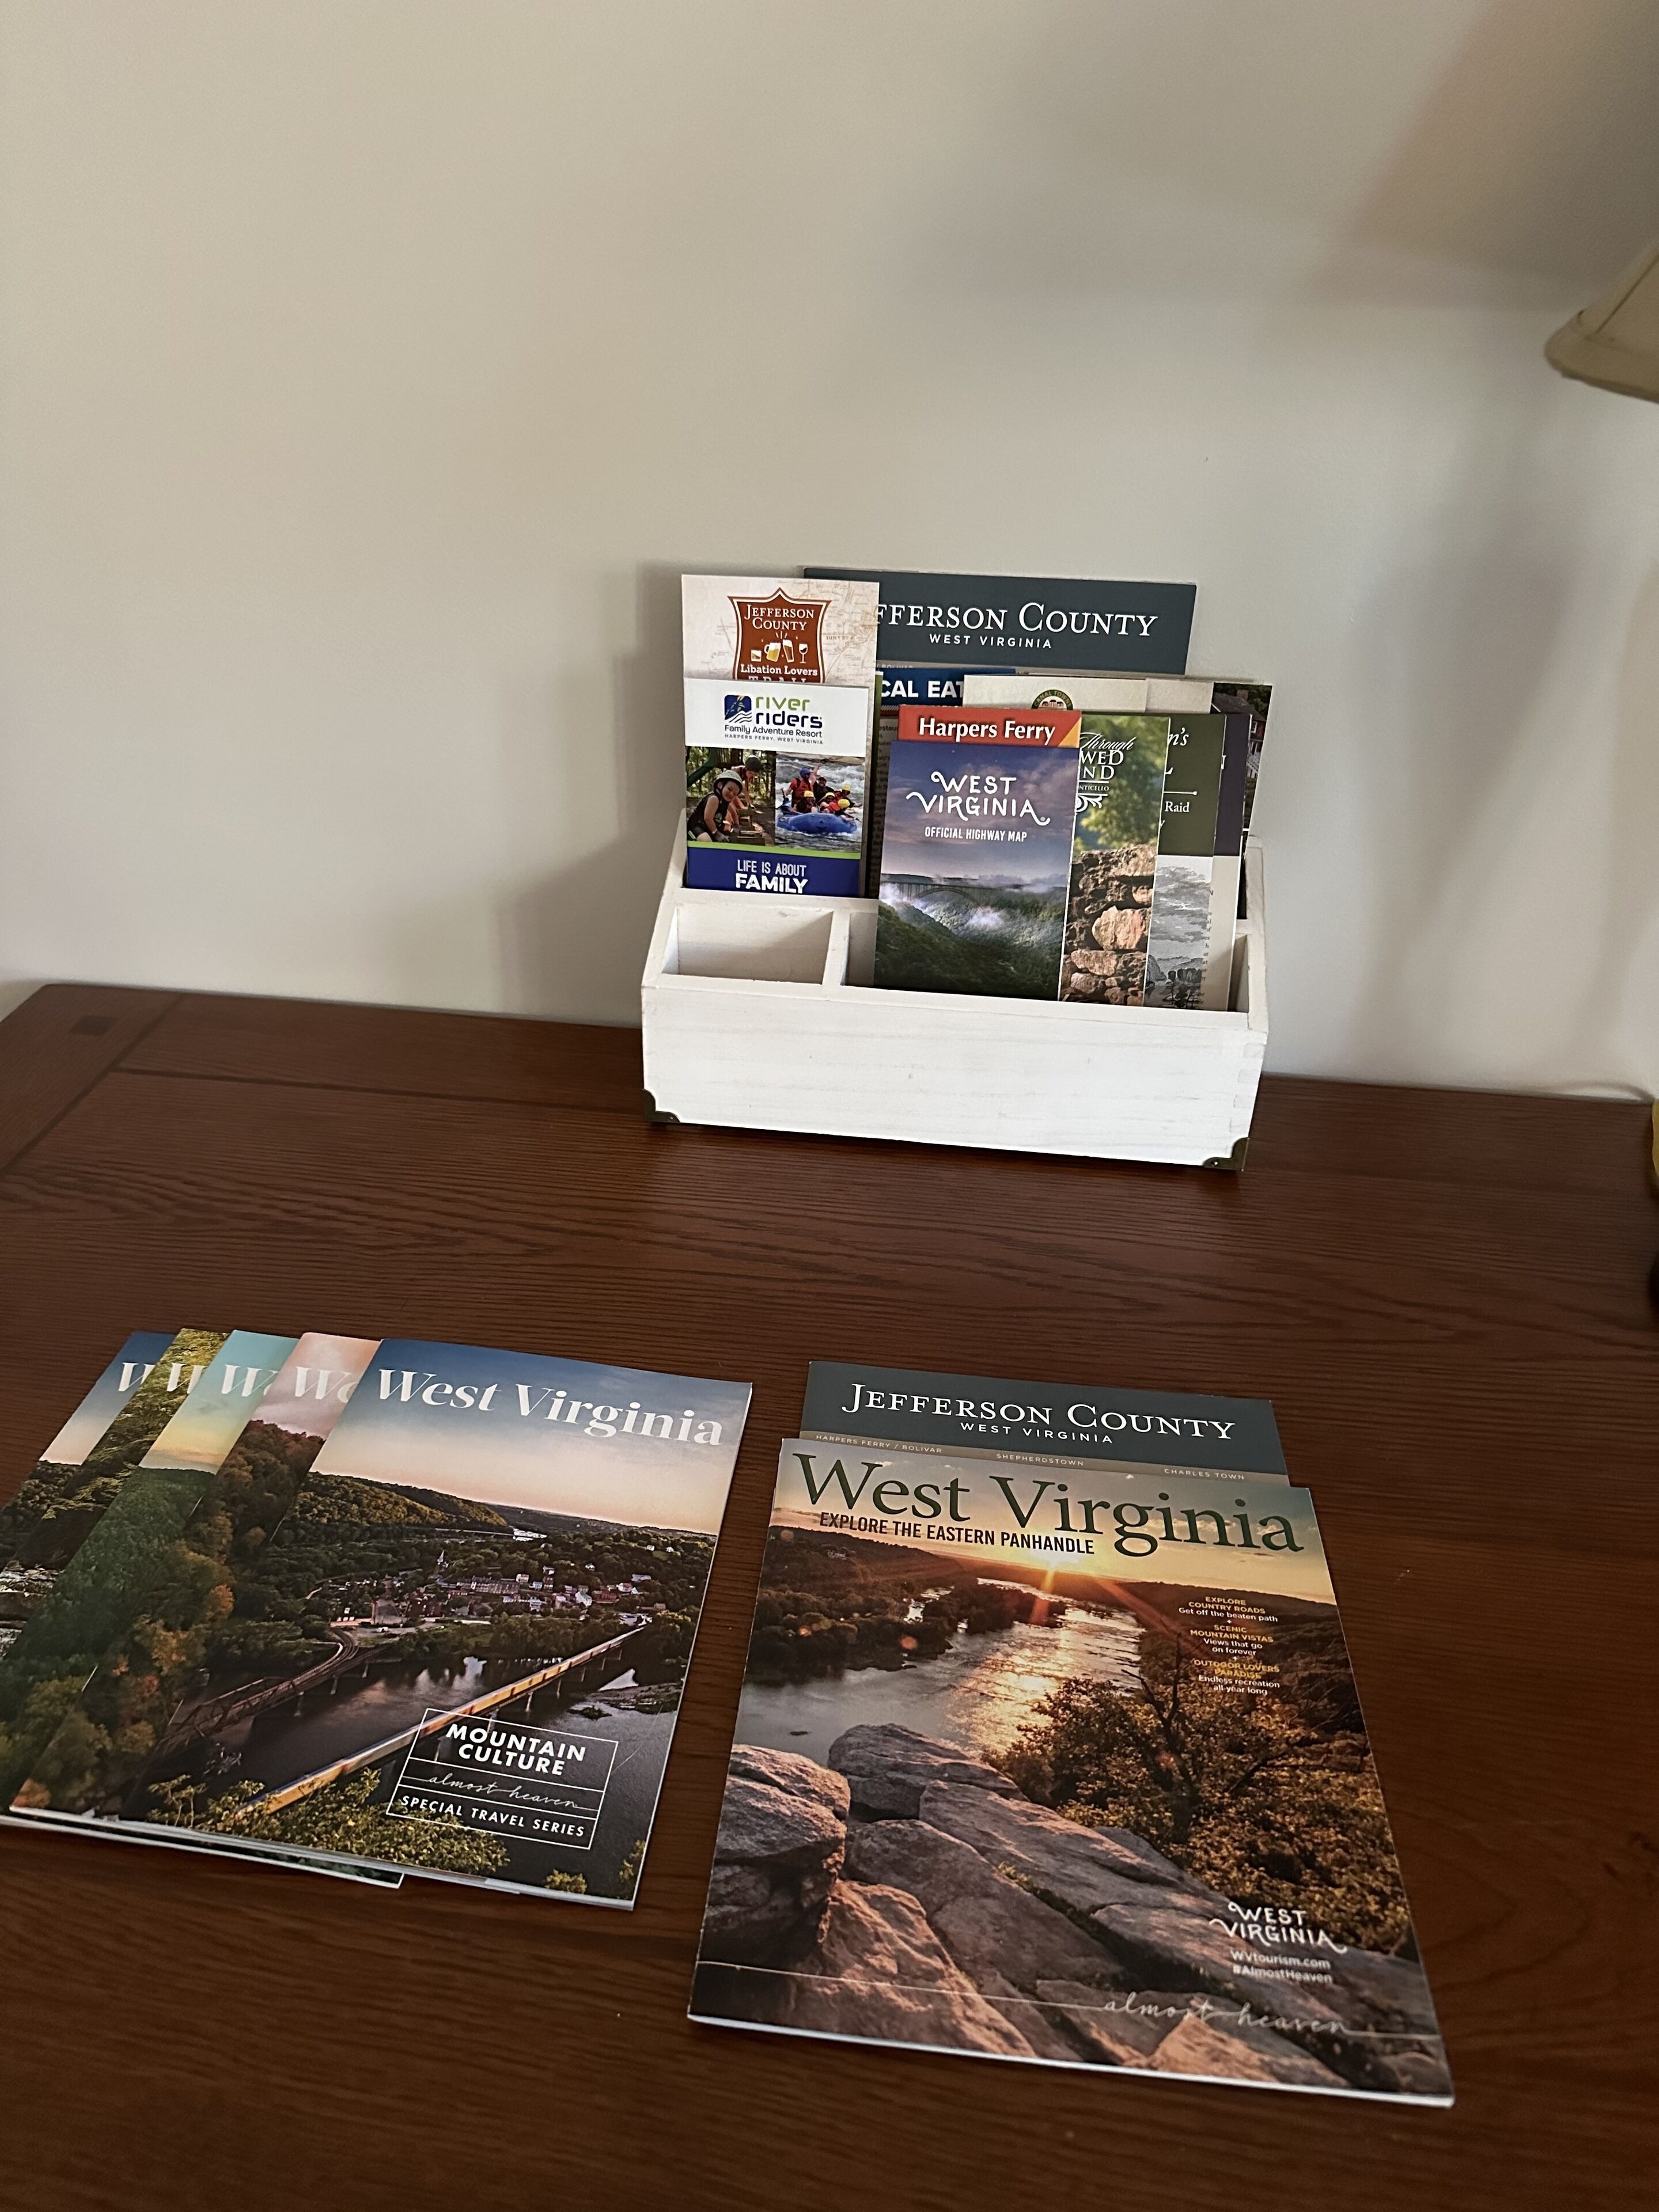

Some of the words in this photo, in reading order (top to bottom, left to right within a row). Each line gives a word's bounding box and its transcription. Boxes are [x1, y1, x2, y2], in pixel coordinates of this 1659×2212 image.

[744, 605, 815, 620] JEFFERSON
[1019, 602, 1158, 636] COUNTY
[752, 617, 807, 631] COUNTY
[929, 634, 972, 645] WEST
[979, 636, 1051, 649] VIRGINIA
[741, 664, 782, 675] Libation
[784, 665, 818, 676] Lovers
[756, 696, 810, 711] river
[756, 711, 823, 729] riders
[725, 725, 750, 734] Family
[752, 726, 794, 736] Adventure
[796, 729, 822, 737] Resort
[919, 718, 997, 742] Harpers
[1005, 721, 1055, 745] Ferry
[931, 771, 1017, 795] WEST
[906, 791, 1050, 825] VIRGINIA
[1165, 801, 1190, 813] Raid
[925, 827, 963, 839] OFFICIAL
[966, 829, 1005, 841] HIGHWAY
[1008, 831, 1027, 842] MAP
[737, 859, 757, 873] LIFE
[762, 862, 771, 874] IS
[775, 863, 806, 877] ABOUT
[736, 873, 808, 893] FAMILY
[221, 1364, 279, 1397] W
[378, 1369, 502, 1411] West
[516, 1383, 722, 1446] Virginia
[842, 1384, 1052, 1425] JEFFERSON
[1067, 1403, 1235, 1440] COUNTY
[960, 1422, 1012, 1435] WEST
[1022, 1428, 1112, 1444] VIRGINIA
[816, 1435, 858, 1445] HARPERS
[902, 1445, 942, 1453] BOLIVAR
[997, 1453, 1084, 1466] SHEPHERDSTOWN
[1164, 1468, 1211, 1478] CHARLES
[1214, 1472, 1244, 1480] TOWN
[793, 1453, 971, 1522] West
[990, 1476, 1304, 1556] Virginia
[820, 1512, 888, 1535] EXPLORE
[893, 1521, 922, 1537] THE
[927, 1525, 995, 1545] EASTERN
[1001, 1532, 1094, 1555] PANHANDLE
[1188, 1601, 1232, 1612] COUNTRY
[1234, 1605, 1266, 1613] ROADS
[1205, 1596, 1247, 1605] EXPLORE
[1226, 1612, 1256, 1620] beaten
[1259, 1615, 1278, 1623] path
[1190, 1630, 1239, 1639] MOUNTAIN
[1241, 1634, 1274, 1642] VISTAS
[1214, 1624, 1247, 1633] SCENIC
[1203, 1638, 1229, 1646] Views
[1226, 1647, 1256, 1656] forever
[1194, 1660, 1240, 1670] OUTDOOR
[1243, 1664, 1279, 1673] LOVERS
[1198, 1675, 1233, 1684] Endless
[1235, 1679, 1280, 1688] recreation
[1247, 1687, 1267, 1695] long
[446, 1724, 585, 1762] MOUNTAIN
[459, 1744, 565, 1776] CULTURE
[429, 1772, 498, 1794] almost
[509, 1786, 578, 1808] heaven
[401, 1796, 462, 1816] SPECIAL
[471, 1808, 525, 1827] TRAVEL
[533, 1819, 585, 1837] SERIES
[1228, 1902, 1306, 1926] WEST
[1209, 1918, 1347, 1954] VIRGINIA
[1230, 1949, 1331, 1969] WVtourism.com
[1233, 1964, 1332, 1983] #AlmostHeaven
[1104, 1991, 1213, 2020] almost
[1238, 2002, 1347, 2034] heaven
